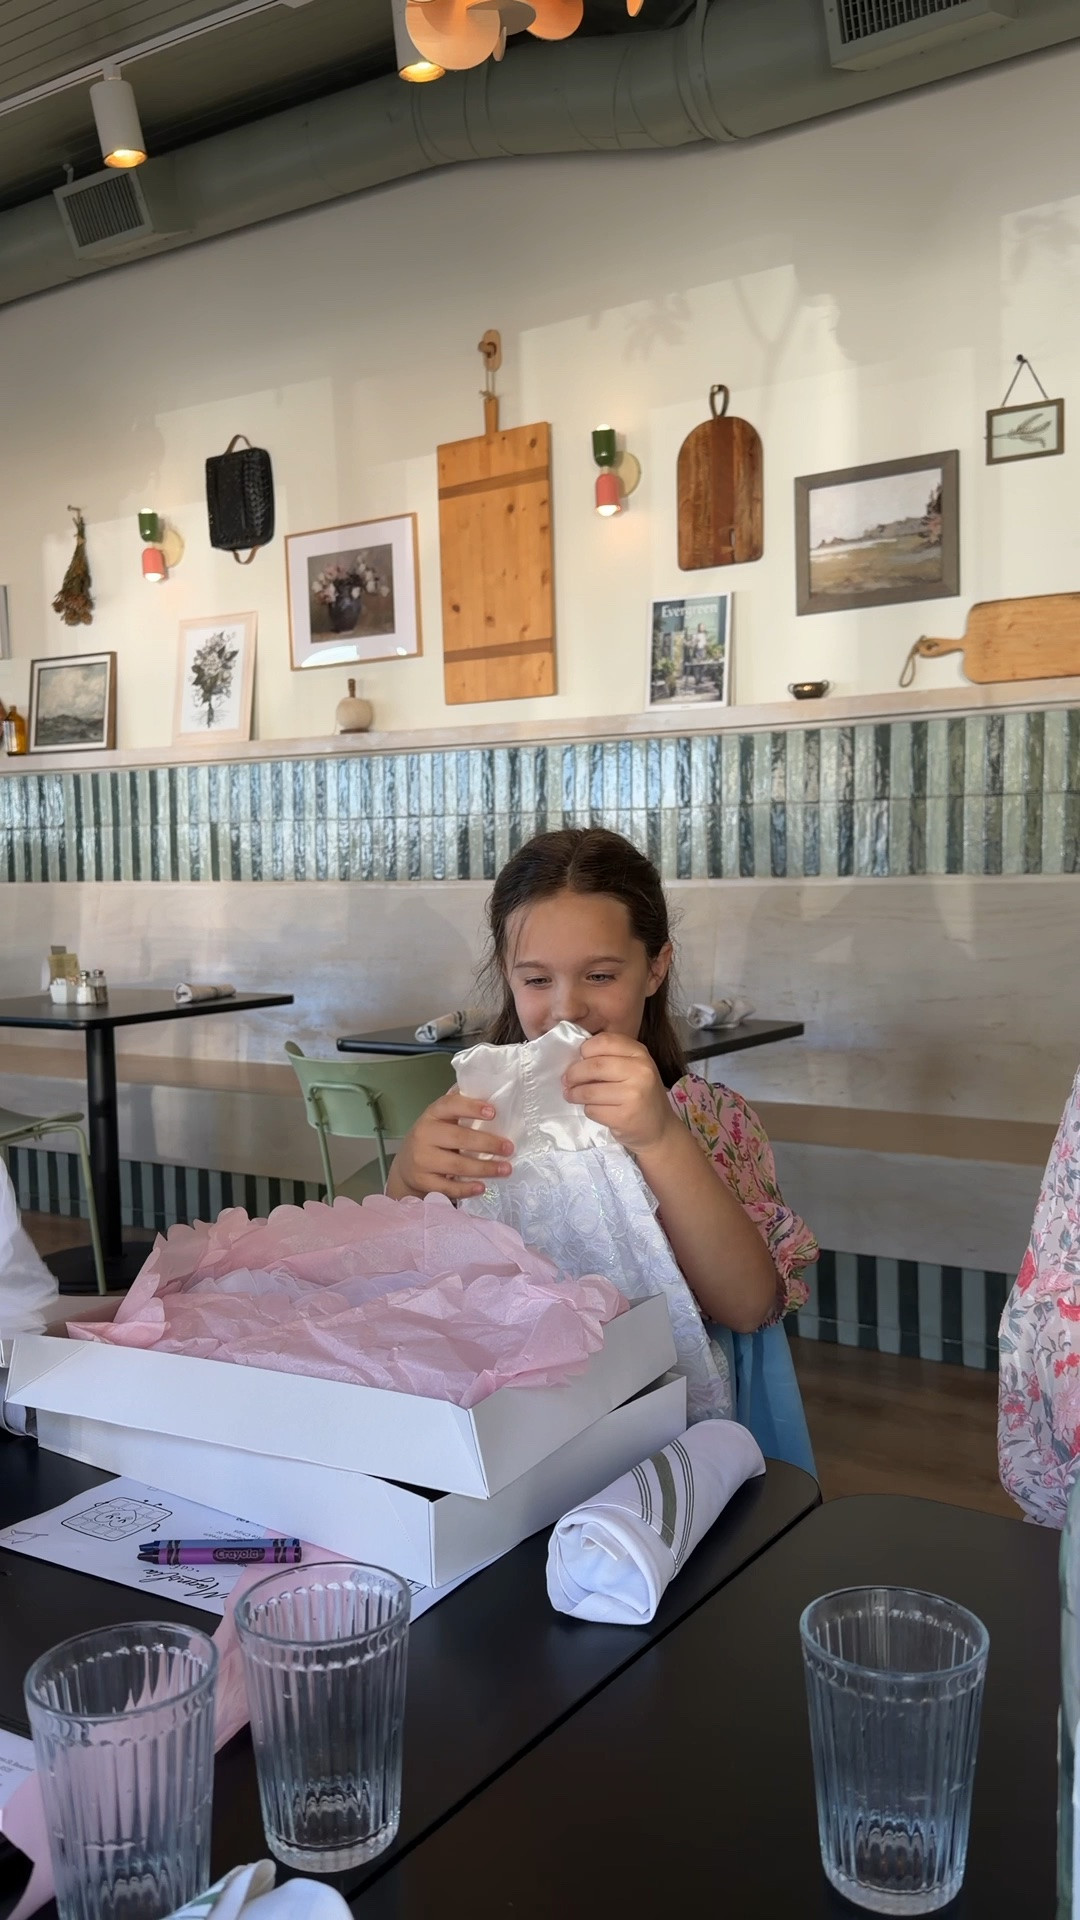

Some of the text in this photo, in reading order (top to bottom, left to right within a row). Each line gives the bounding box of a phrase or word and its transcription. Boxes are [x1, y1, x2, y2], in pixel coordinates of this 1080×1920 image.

[661, 604, 718, 618] Evergreen
[216, 1547, 260, 1560] Crayola
[138, 1569, 230, 1599] Magnolia
